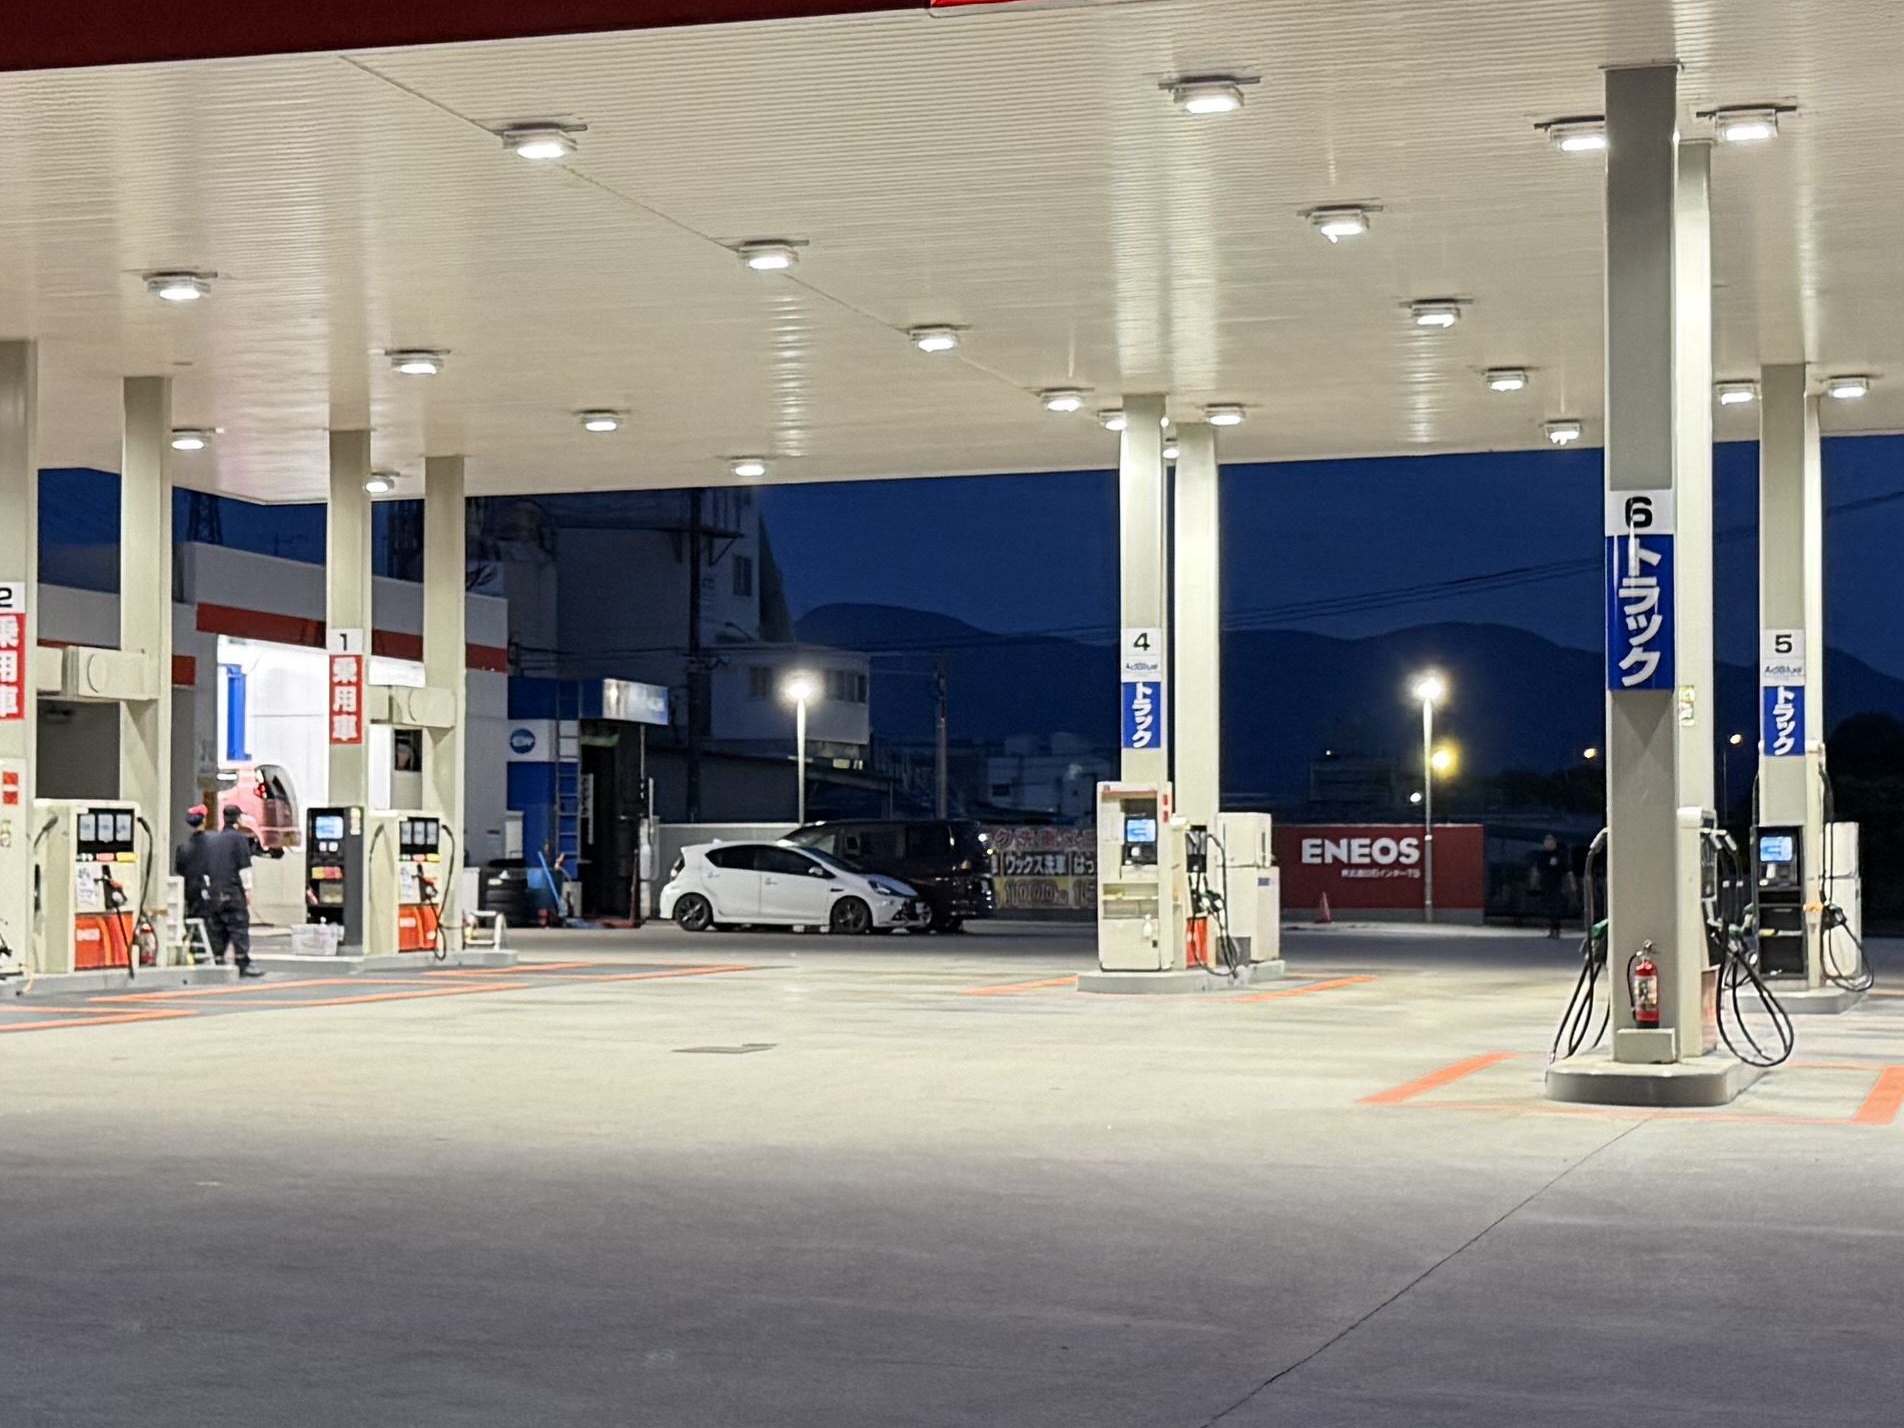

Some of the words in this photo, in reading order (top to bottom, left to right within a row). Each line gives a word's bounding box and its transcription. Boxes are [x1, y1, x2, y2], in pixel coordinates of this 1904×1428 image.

[1625, 496, 1654, 528] 6
[1618, 537, 1663, 687] トラック
[339, 633, 348, 652] 1
[1133, 632, 1151, 651] 4
[1774, 634, 1793, 654] 5
[332, 656, 358, 741] 乗用車
[1132, 682, 1153, 749] トラック
[1772, 686, 1795, 756] トラック
[1301, 837, 1420, 864] ENEOS
